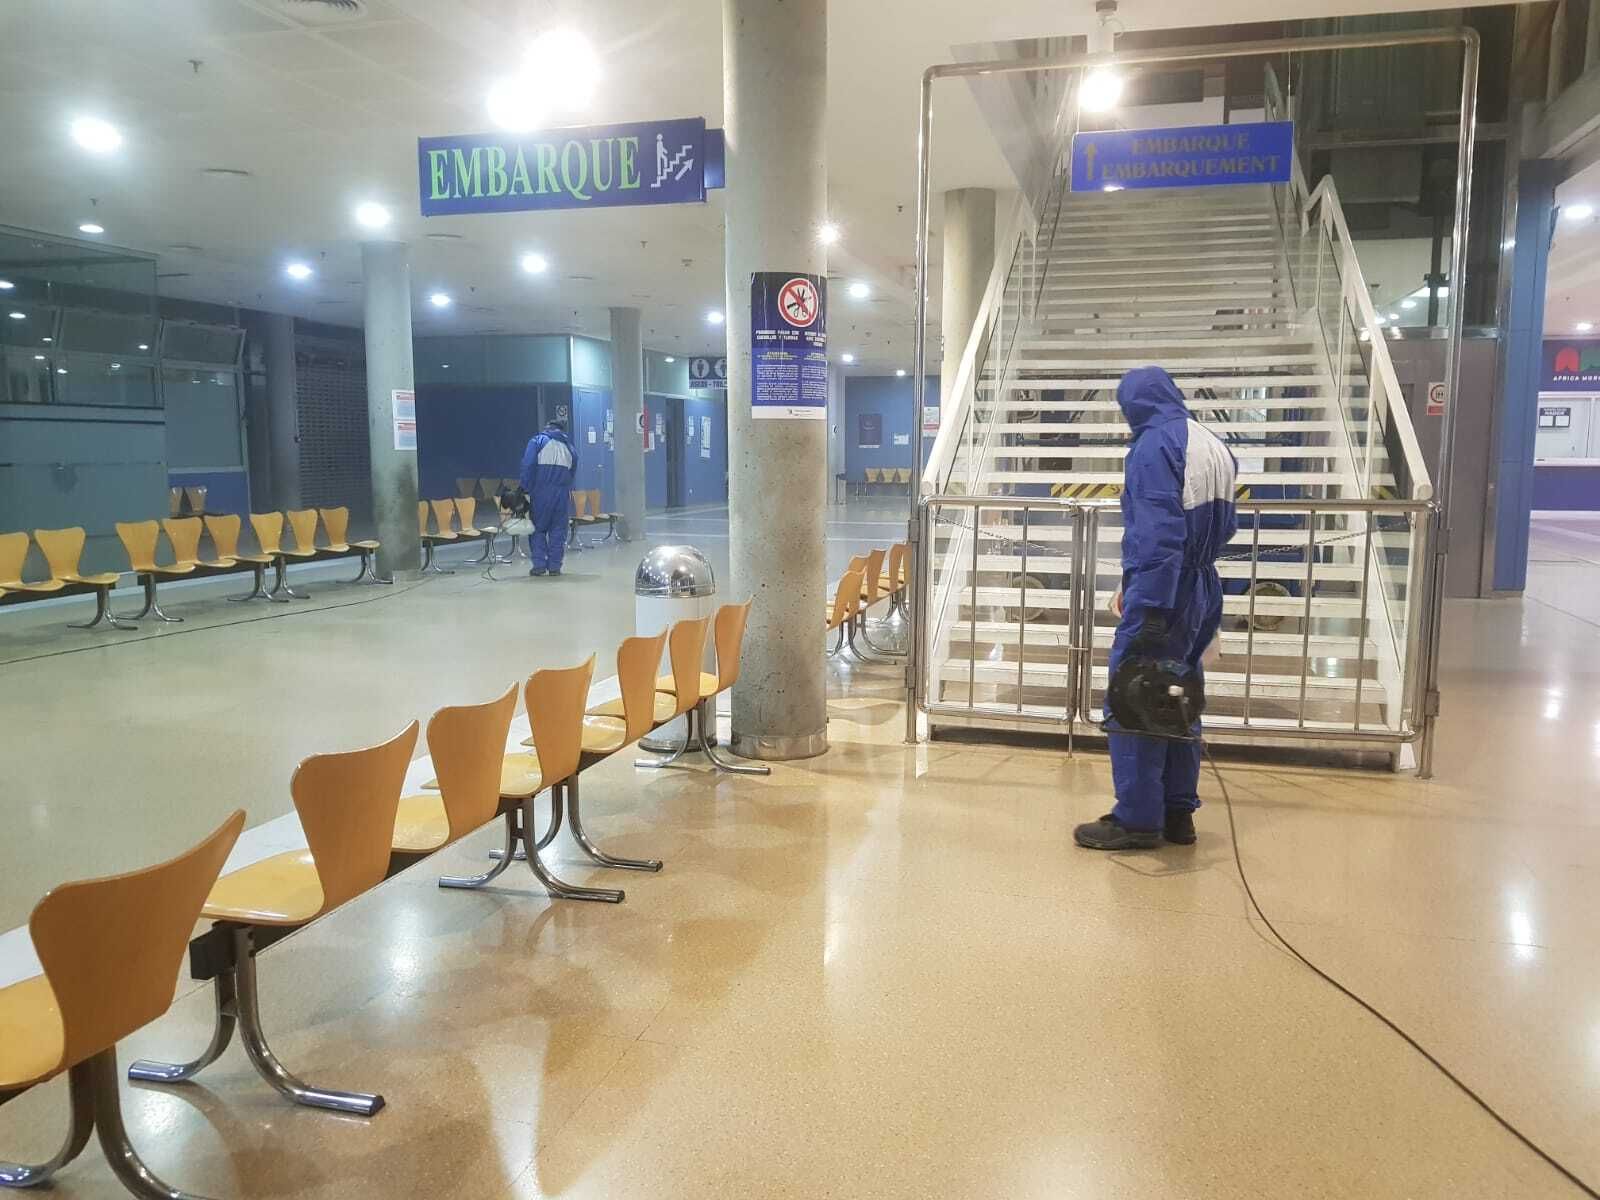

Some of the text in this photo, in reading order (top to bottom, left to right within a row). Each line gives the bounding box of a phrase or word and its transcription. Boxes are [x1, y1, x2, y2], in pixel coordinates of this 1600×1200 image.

[1131, 132, 1249, 155] EMBARQUE
[427, 135, 641, 200] EMBARQUE
[1102, 155, 1281, 180] EMBARQUEMENT
